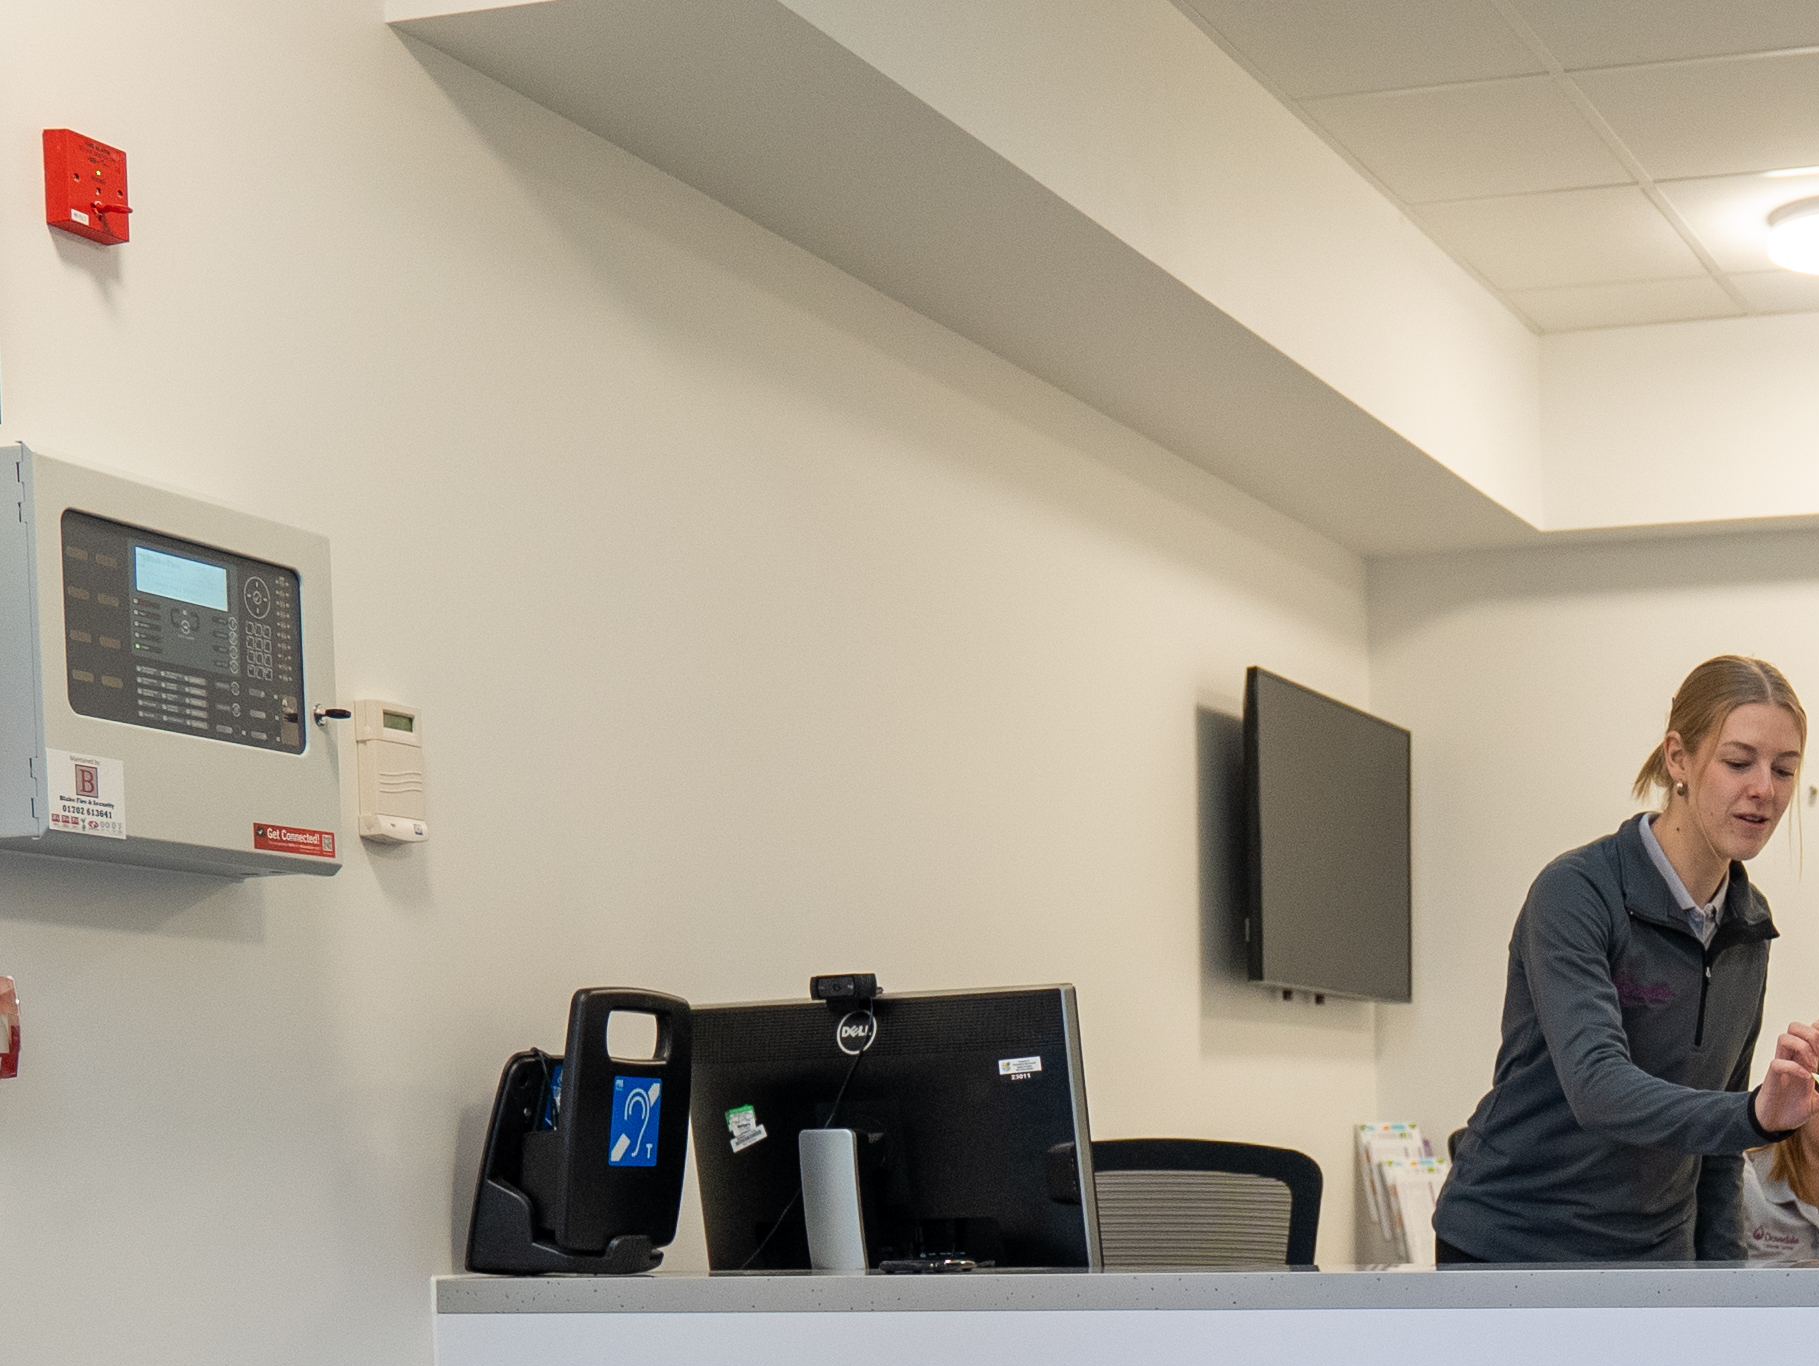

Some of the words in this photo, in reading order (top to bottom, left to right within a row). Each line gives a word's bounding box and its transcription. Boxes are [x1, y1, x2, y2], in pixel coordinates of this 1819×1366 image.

[80, 769, 95, 793] B
[62, 804, 86, 815] 01202
[267, 828, 280, 839] Get
[645, 1143, 654, 1160] T
